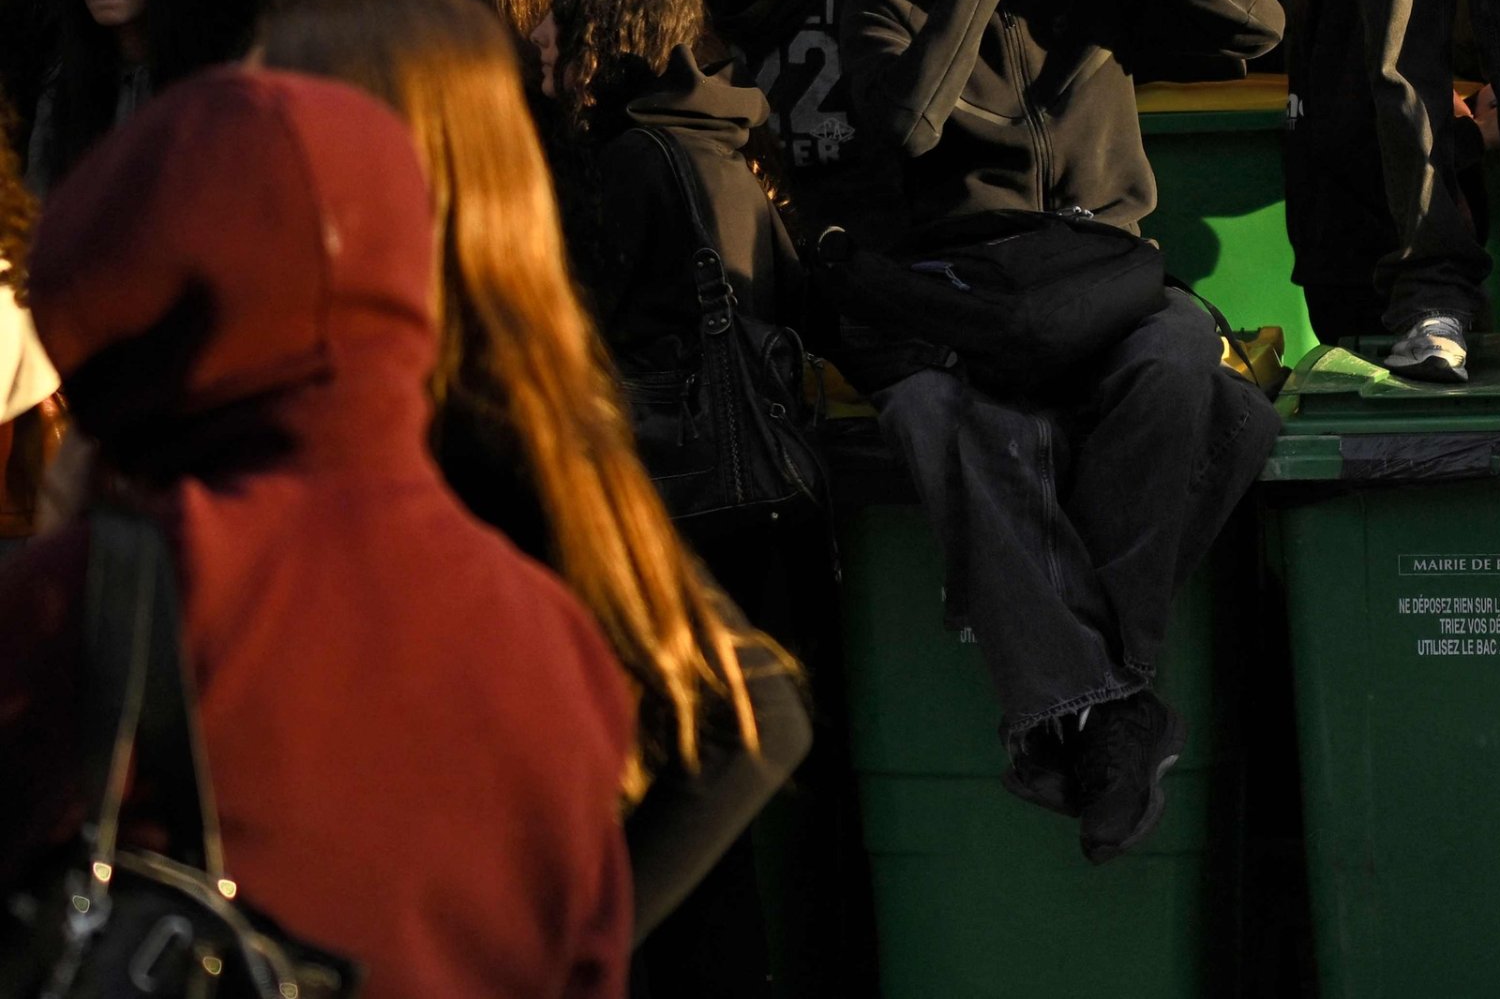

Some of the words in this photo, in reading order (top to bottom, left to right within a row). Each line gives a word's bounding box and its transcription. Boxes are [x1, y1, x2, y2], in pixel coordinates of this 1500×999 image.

[1413, 558, 1467, 571] MAIRIE
[1472, 558, 1492, 571] DE
[1399, 598, 1411, 614] NE
[1412, 594, 1452, 614] DÉPOSEZ
[1453, 598, 1474, 614] RIEN
[1474, 598, 1493, 613] SUR
[1439, 618, 1466, 635] TRIEZ
[1467, 618, 1488, 635] VOS
[1417, 639, 1460, 656] UTILISEZ
[1461, 639, 1474, 655] LE
[1476, 639, 1497, 655] BAC
